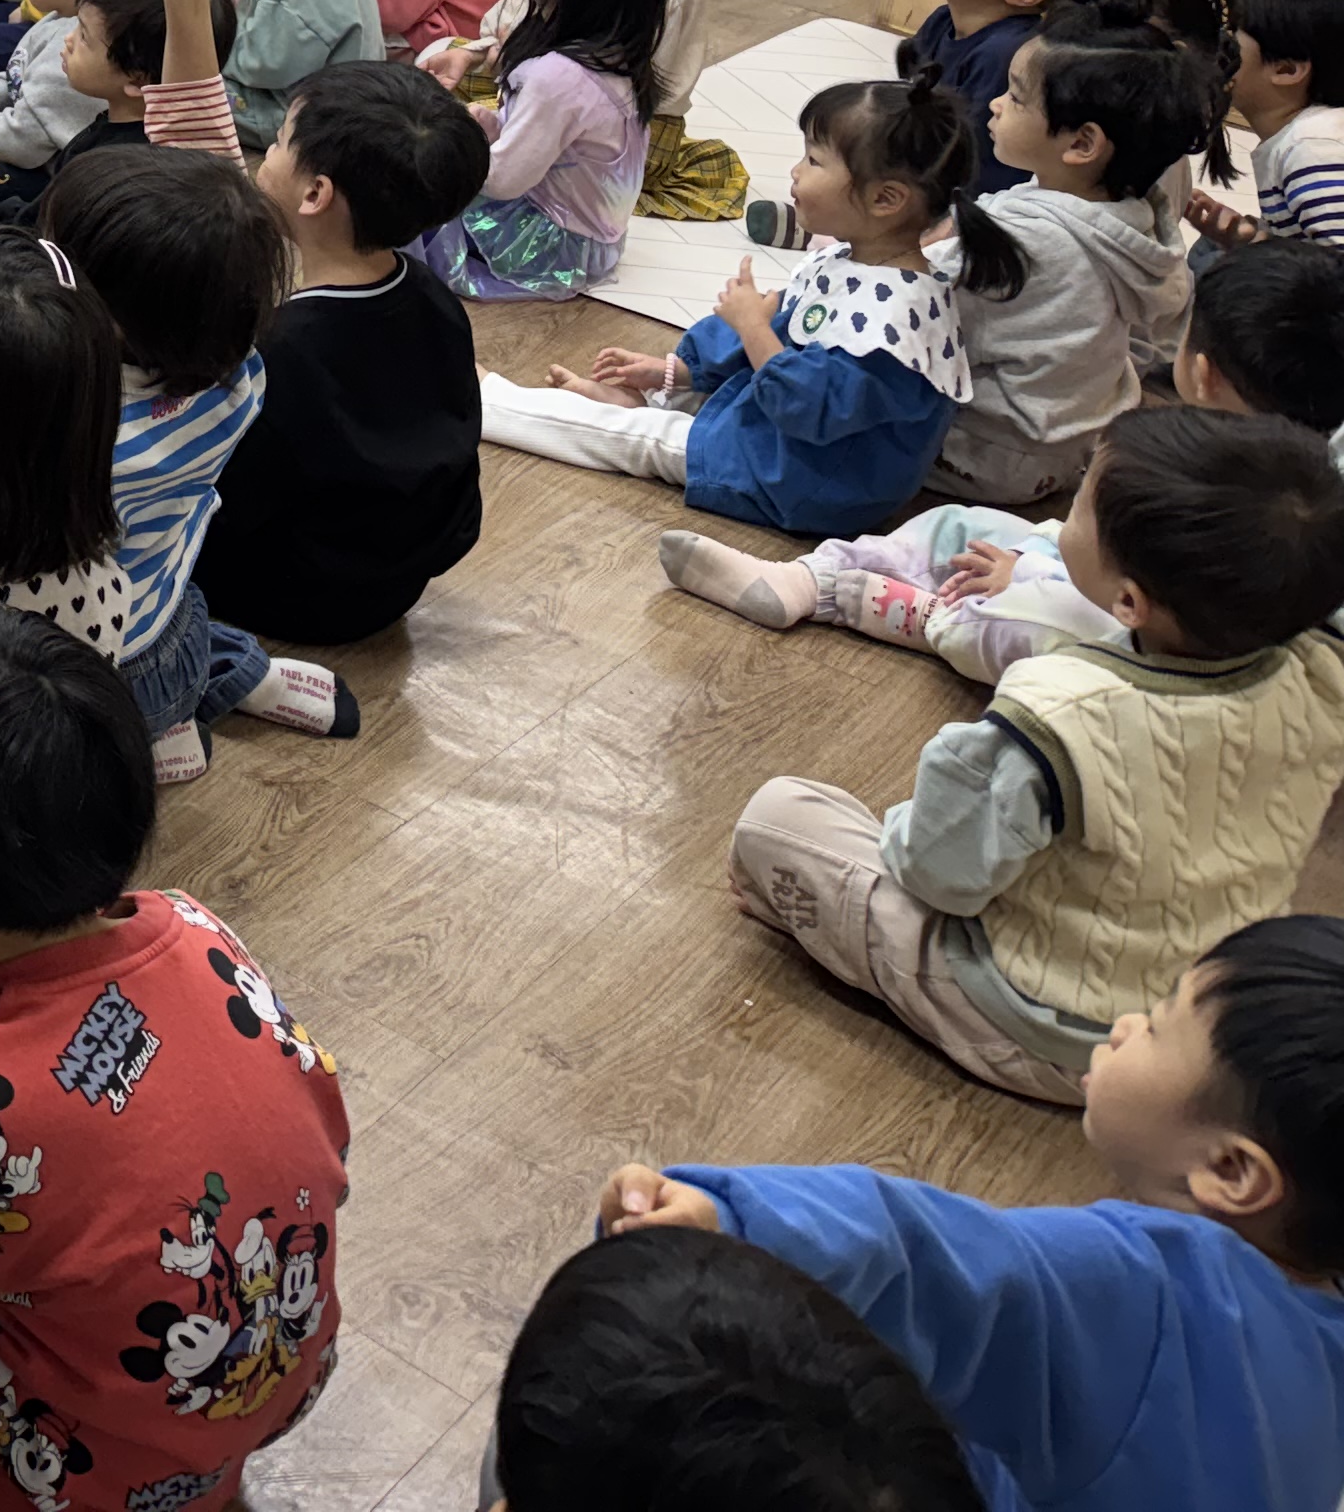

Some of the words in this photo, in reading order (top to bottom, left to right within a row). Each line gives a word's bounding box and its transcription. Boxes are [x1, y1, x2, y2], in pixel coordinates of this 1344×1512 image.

[279, 667, 304, 683] PAUL
[792, 883, 818, 931] AIR
[52, 982, 126, 1093] MICKEY
[79, 1001, 145, 1104] MOUSE
[116, 1029, 161, 1094] Friends
